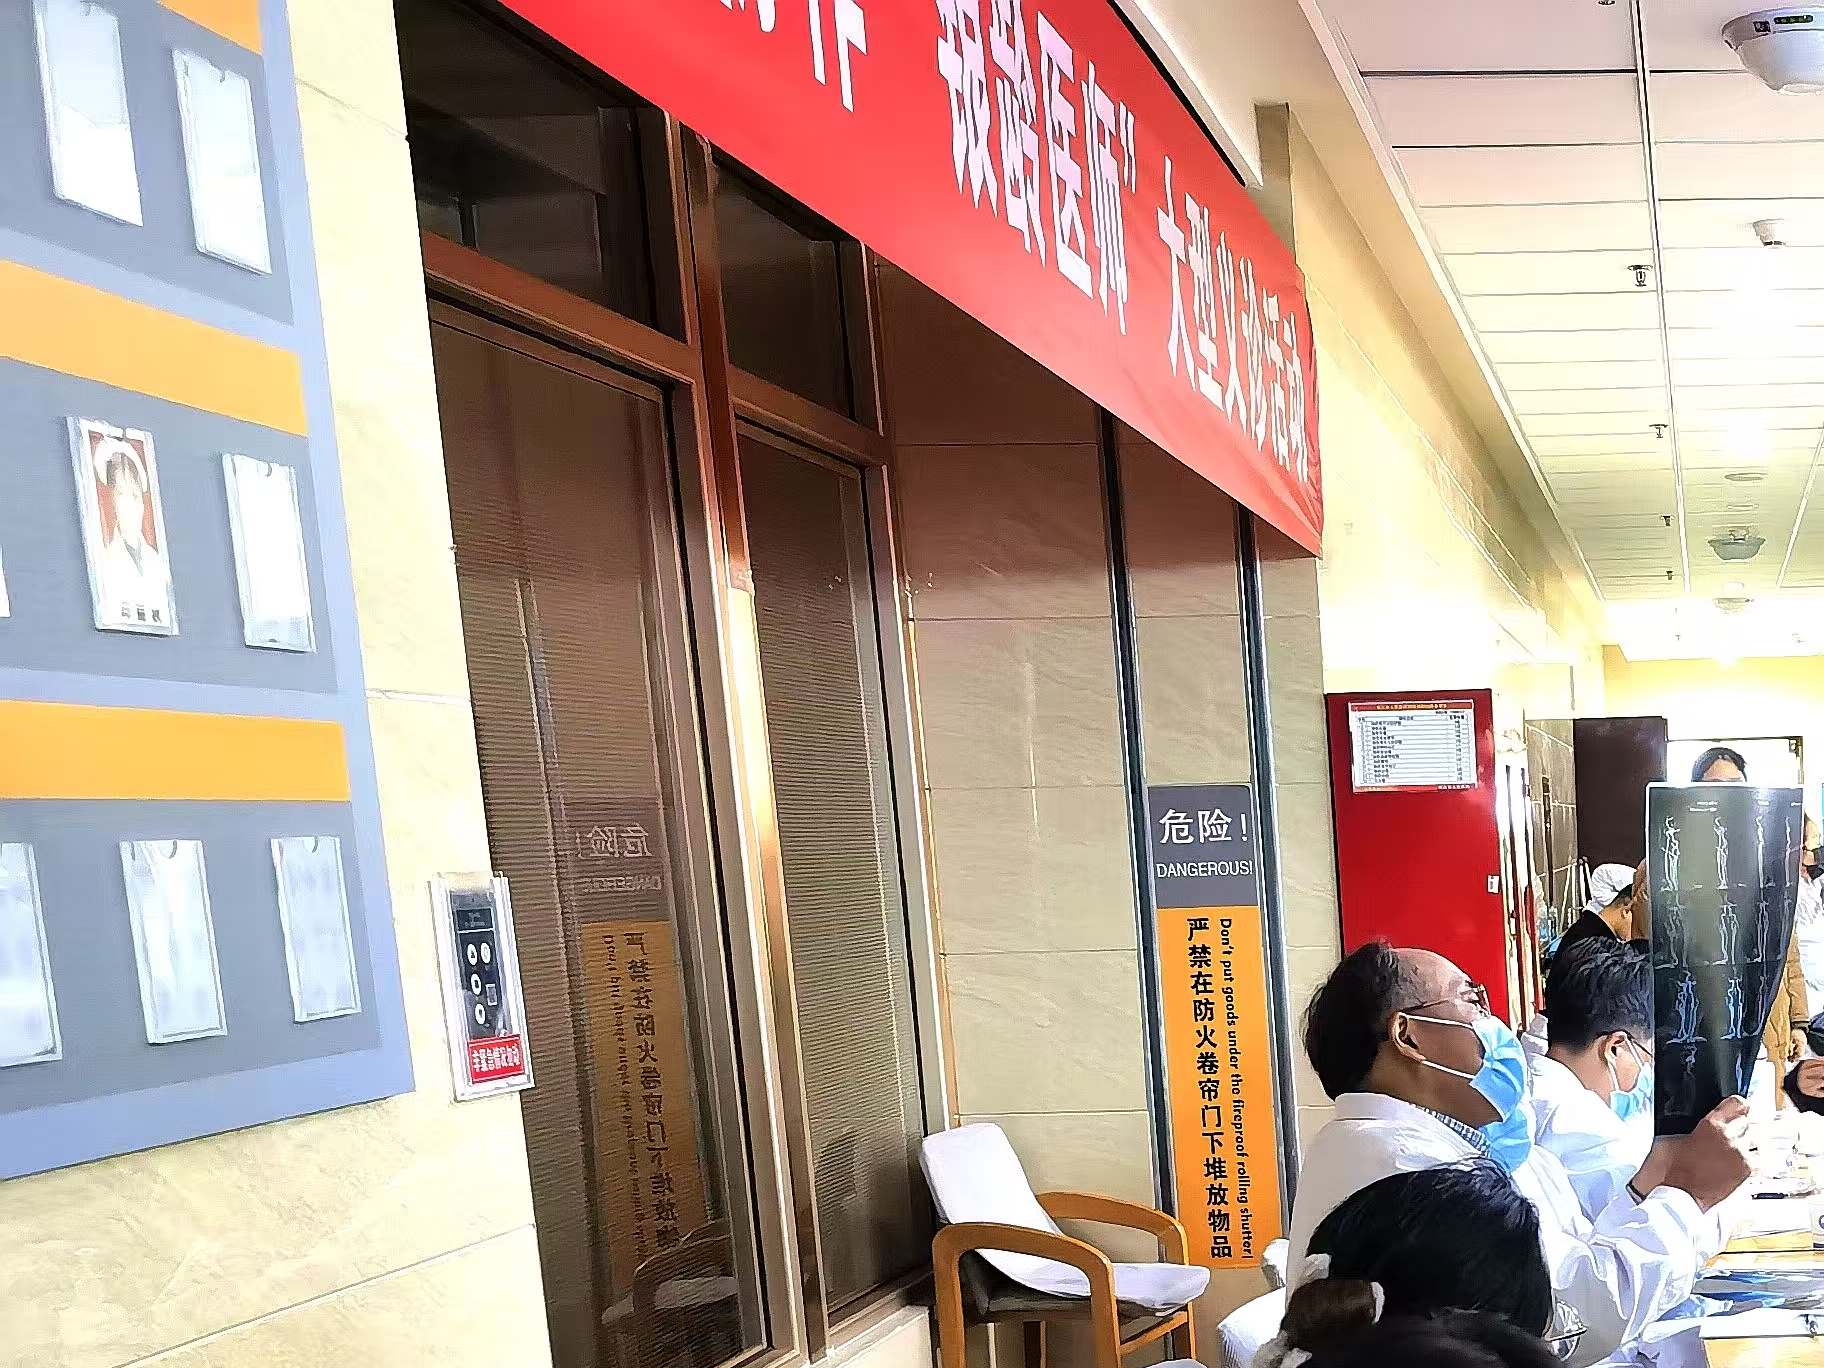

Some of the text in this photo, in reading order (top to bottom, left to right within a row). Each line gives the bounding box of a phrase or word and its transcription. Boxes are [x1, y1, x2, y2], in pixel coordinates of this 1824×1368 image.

[1156, 860, 1254, 878] DANGEROUS!
[1219, 918, 1235, 956] Don't
[1220, 960, 1234, 983] put
[1221, 986, 1239, 1027] goods
[1227, 1029, 1241, 1070] under
[1186, 917, 1233, 1259] 严禁在防火卷帘门下堆放物品
[1230, 1072, 1243, 1095] the
[1231, 1099, 1248, 1158] fireproof
[1237, 1161, 1251, 1204] rolling
